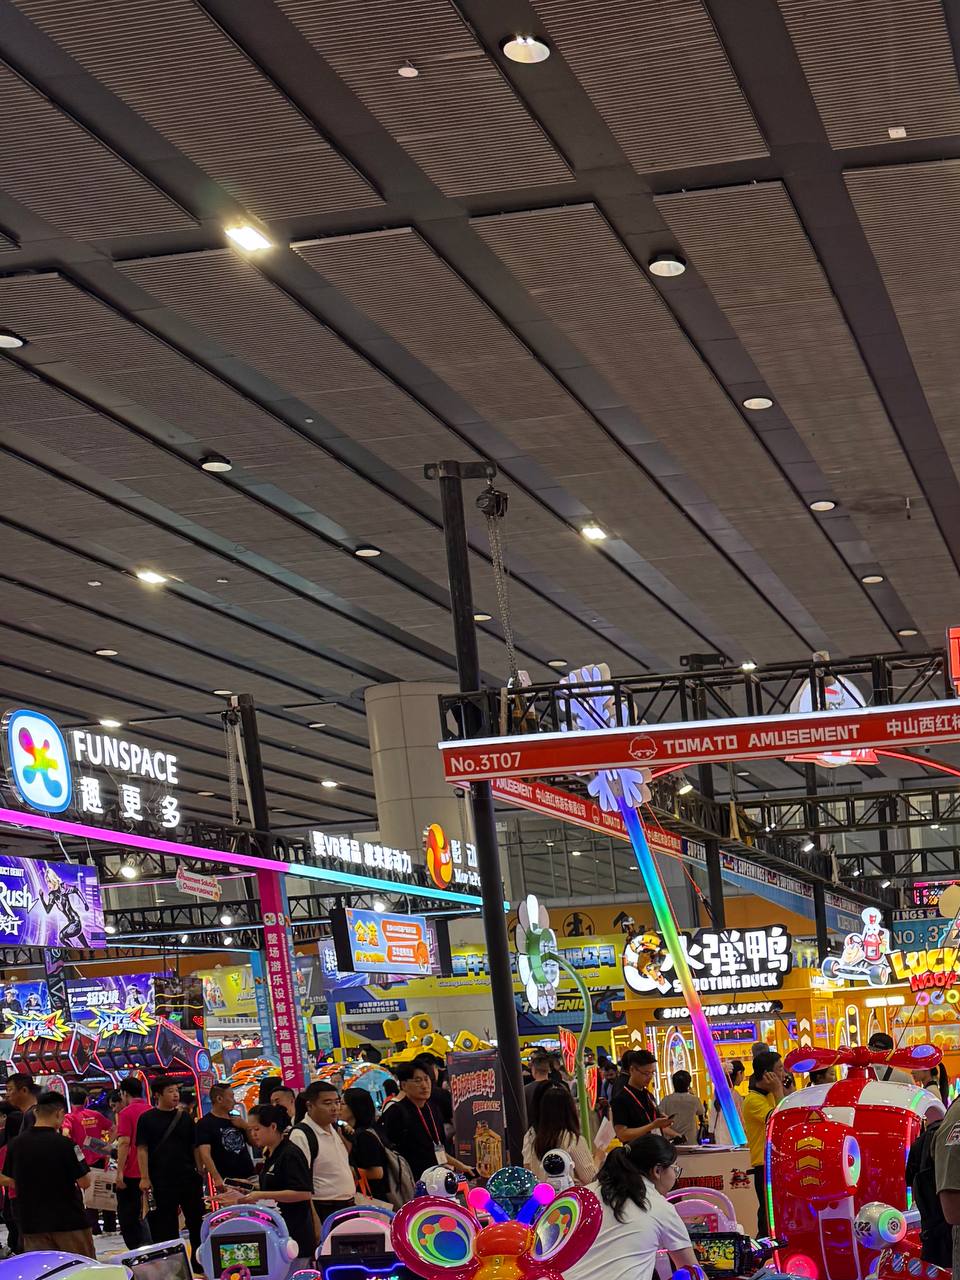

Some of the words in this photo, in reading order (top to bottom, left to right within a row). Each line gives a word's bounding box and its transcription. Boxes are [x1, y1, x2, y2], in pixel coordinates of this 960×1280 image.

[663, 735, 738, 755] TOMATO
[748, 724, 860, 748] AMUSEMENT
[73, 730, 179, 784] FUNSPACE
[450, 752, 521, 773] No.3T07
[80, 777, 181, 828] 趣更多
[741, 972, 778, 989] DUCK
[267, 933, 295, 1081] 整场游乐设备就选趣更多
[662, 1004, 728, 1020] SHOTING
[729, 1001, 773, 1015] LUCKY
